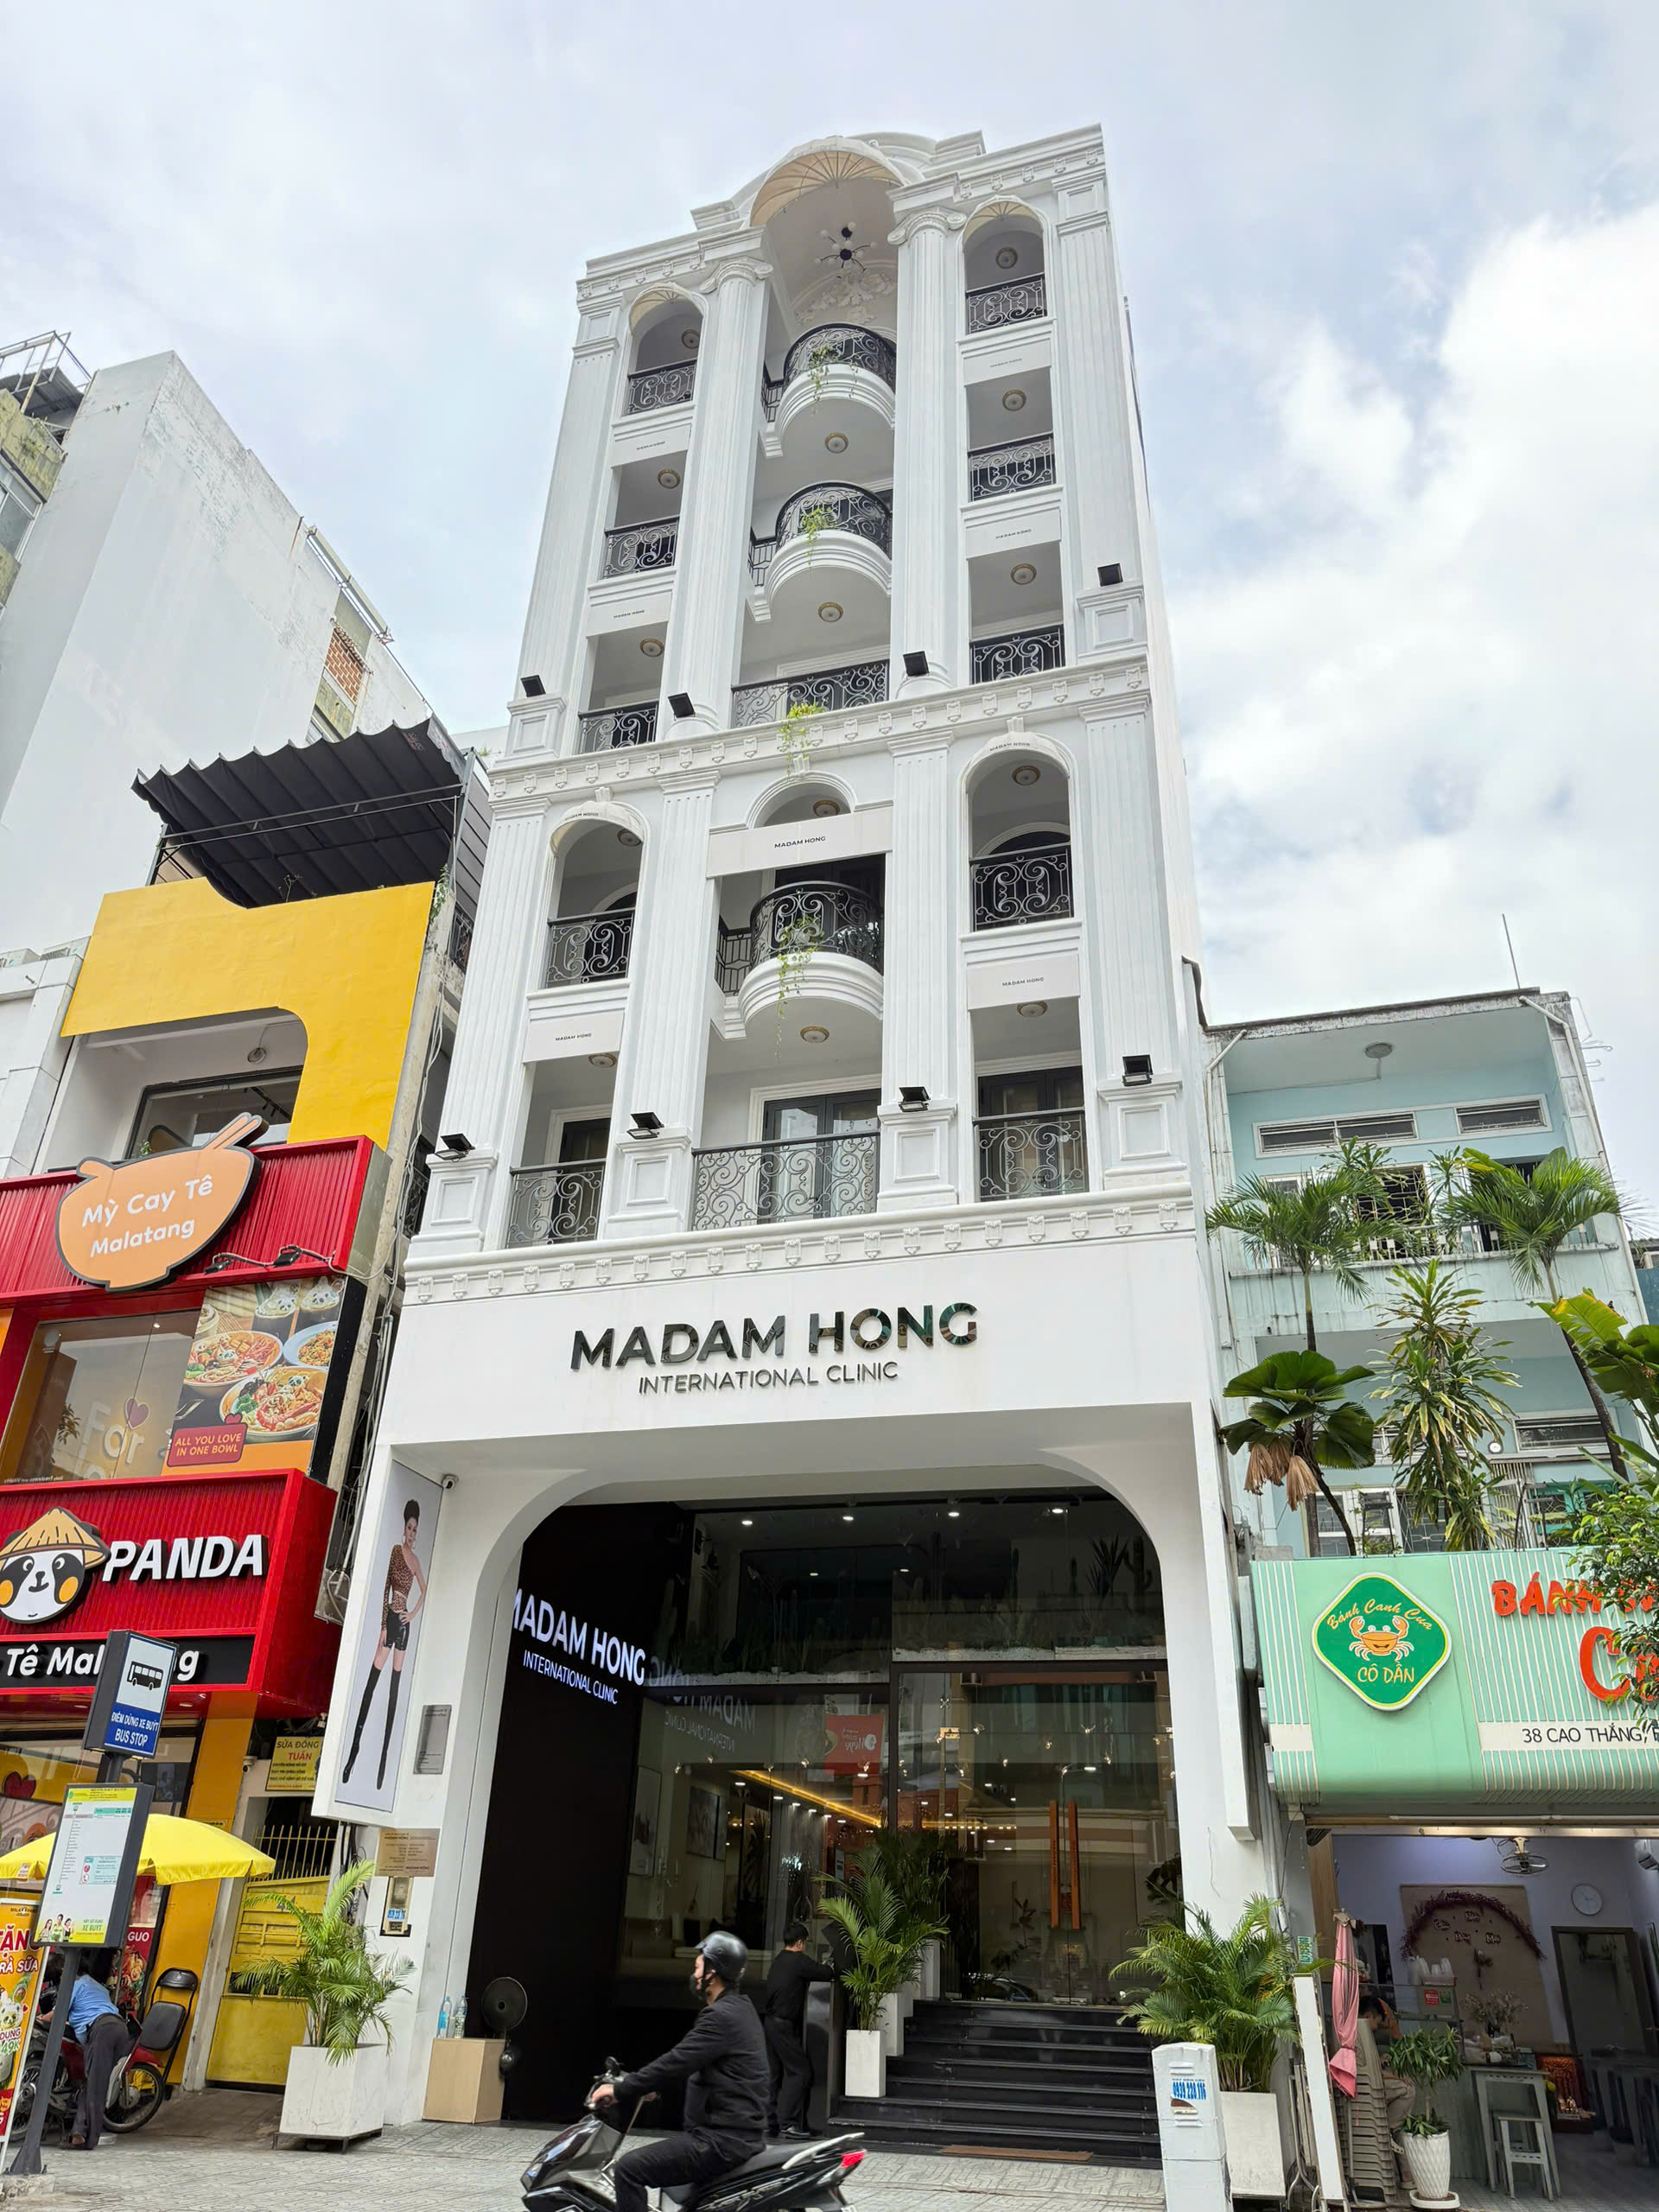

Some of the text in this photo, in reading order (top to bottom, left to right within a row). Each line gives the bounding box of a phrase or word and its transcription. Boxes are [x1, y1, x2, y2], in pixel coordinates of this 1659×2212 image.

[774, 839, 803, 849] MADAM
[82, 1174, 213, 1227] Mỳ Cay Tê
[90, 1219, 194, 1258] Malatang
[570, 1302, 978, 1370] MADAM HONG
[639, 1361, 899, 1395] INTERNATIONAL CLINIC
[175, 1433, 242, 1446] ALL YOU LOVE
[176, 1444, 238, 1457] IN ONE BOWL
[102, 1535, 264, 1581] PANDA
[1327, 1599, 1433, 1630] Bánh Canh Cua
[6, 1643, 39, 1677] Tê
[591, 1627, 645, 1686] HONG
[523, 1649, 591, 1694] INTERNATIONAL
[593, 1681, 618, 1705] CLINIC
[1357, 1661, 1414, 1684] CÔ DẦN
[114, 1728, 149, 1747] BUS STOP
[138, 1719, 146, 1729] XE
[1522, 1728, 1542, 1744] 38
[1547, 1728, 1581, 1743] CAO
[128, 1931, 149, 1942] GUO
